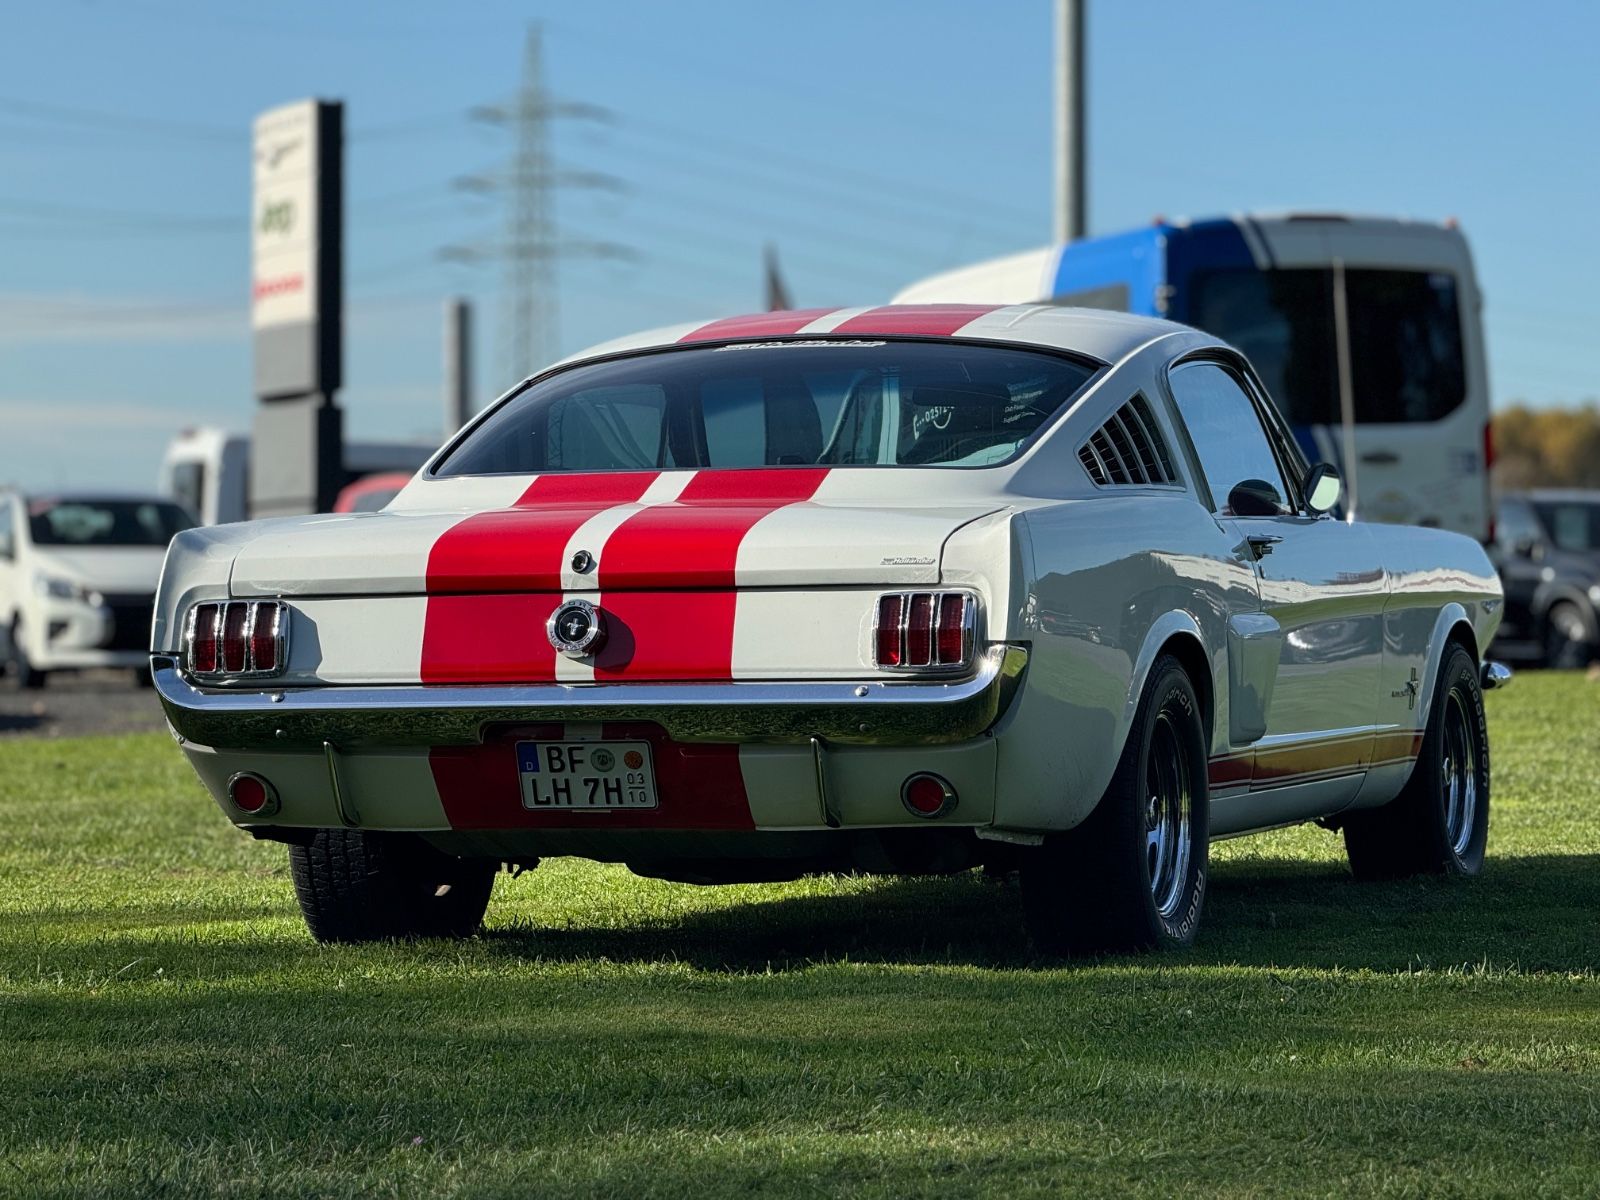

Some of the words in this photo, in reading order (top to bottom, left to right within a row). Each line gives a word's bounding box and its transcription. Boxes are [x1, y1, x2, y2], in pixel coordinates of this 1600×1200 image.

[559, 600, 594, 615] FORD
[526, 761, 533, 771] D
[546, 746, 584, 773] BF
[626, 773, 645, 785] 03
[532, 778, 573, 805] LH
[583, 777, 624, 805] 7H
[628, 791, 647, 803] 10
[1179, 868, 1204, 938] Radial
